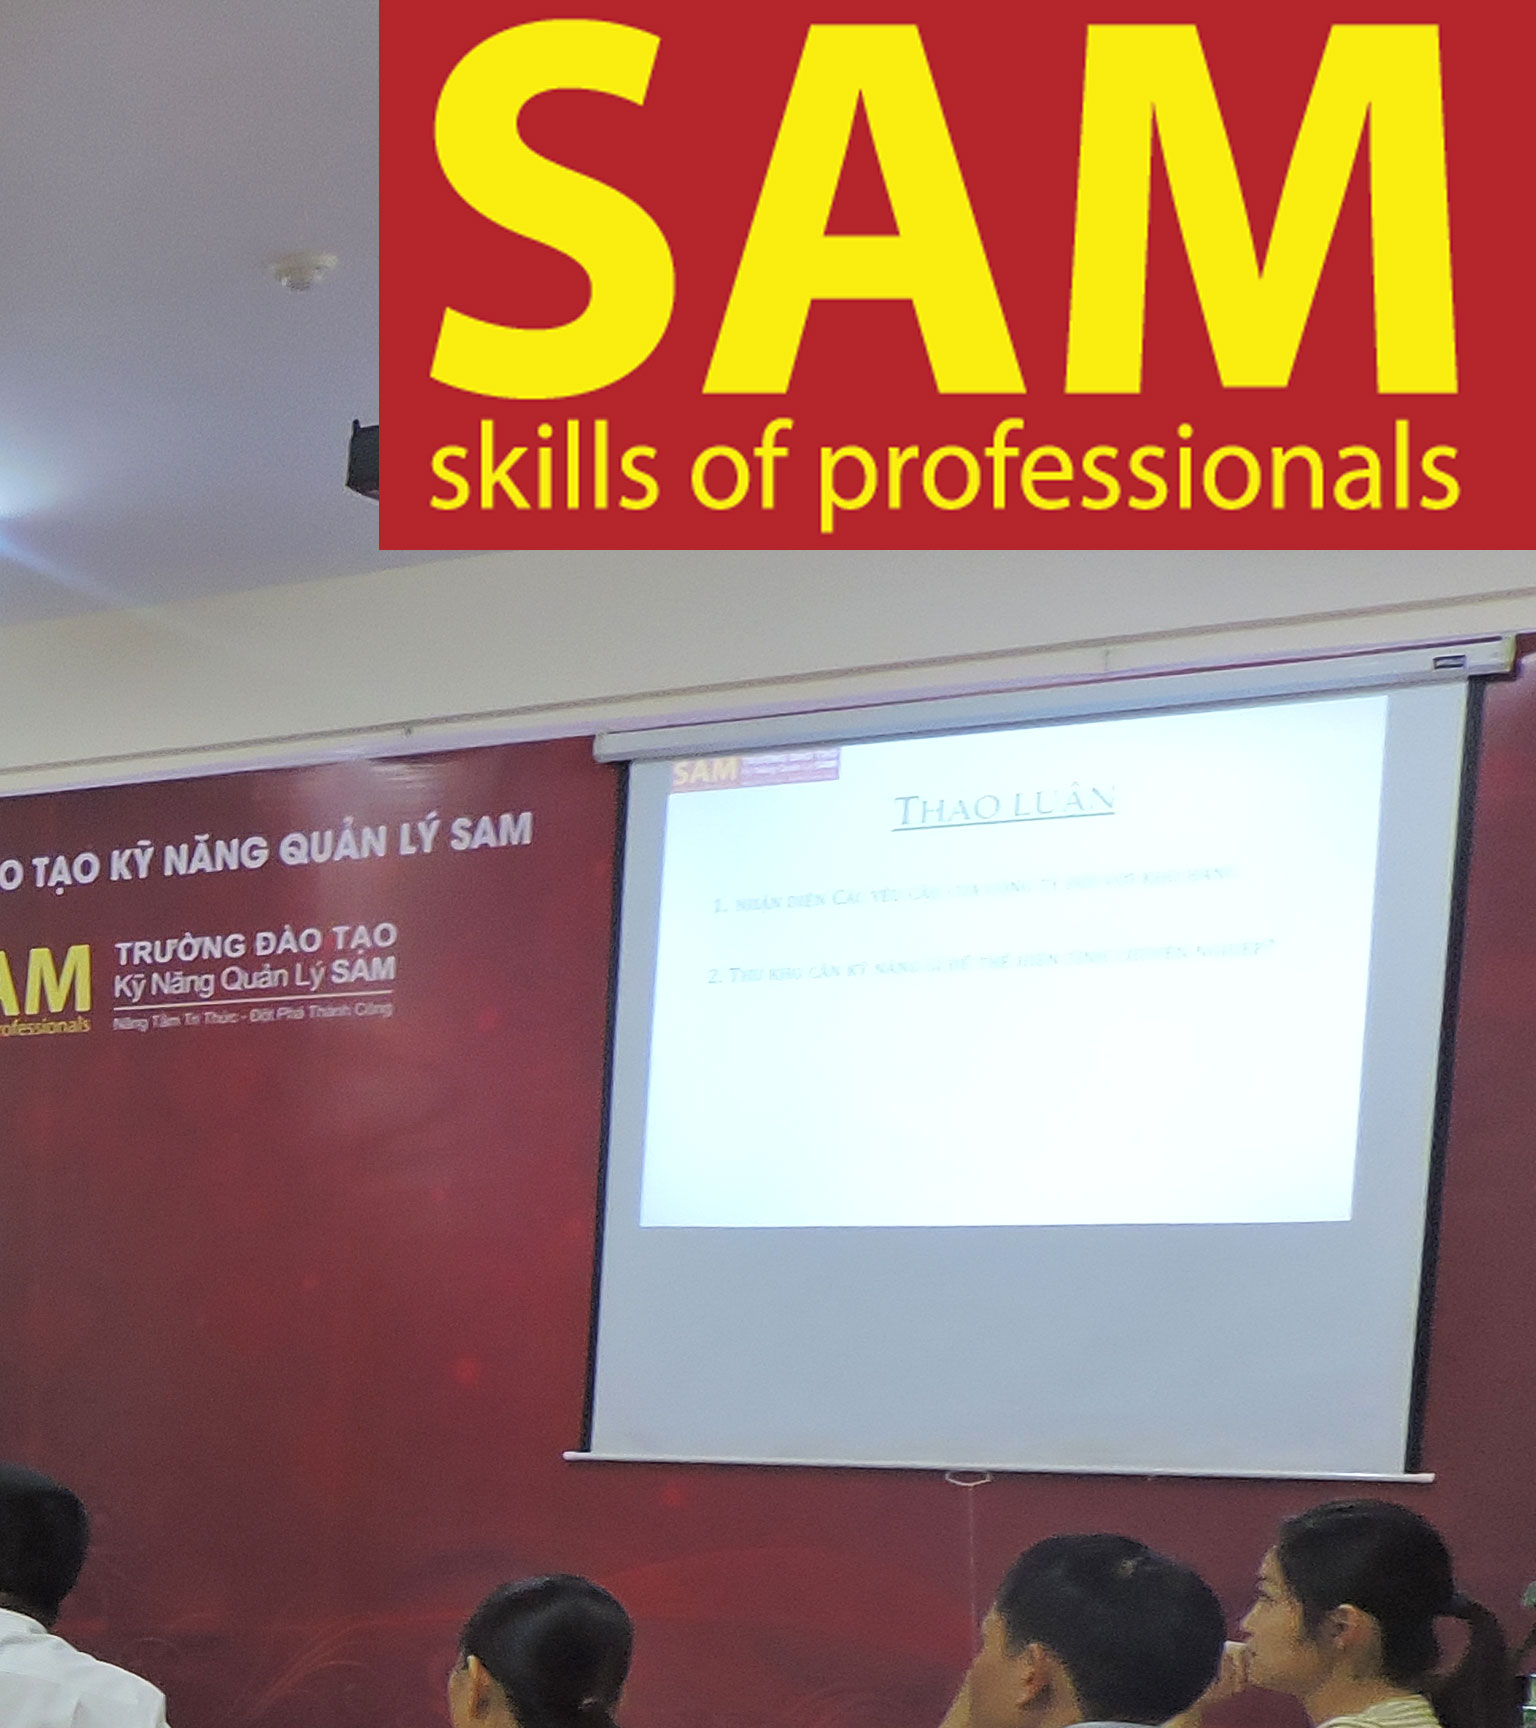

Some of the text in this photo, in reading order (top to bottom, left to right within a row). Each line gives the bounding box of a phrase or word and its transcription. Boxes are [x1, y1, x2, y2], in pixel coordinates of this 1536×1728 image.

[31, 852, 101, 895] TẠO
[109, 839, 155, 881] KỸ
[163, 833, 270, 877] NĂNG
[278, 815, 387, 866] QUẢN
[399, 810, 441, 856] LÝ
[450, 811, 533, 851] SAM
[114, 921, 398, 966] TRƯỜNG ĐÀO TẠO
[220, 963, 289, 992] Quản
[295, 960, 326, 992] Lý
[330, 956, 396, 984] SAM
